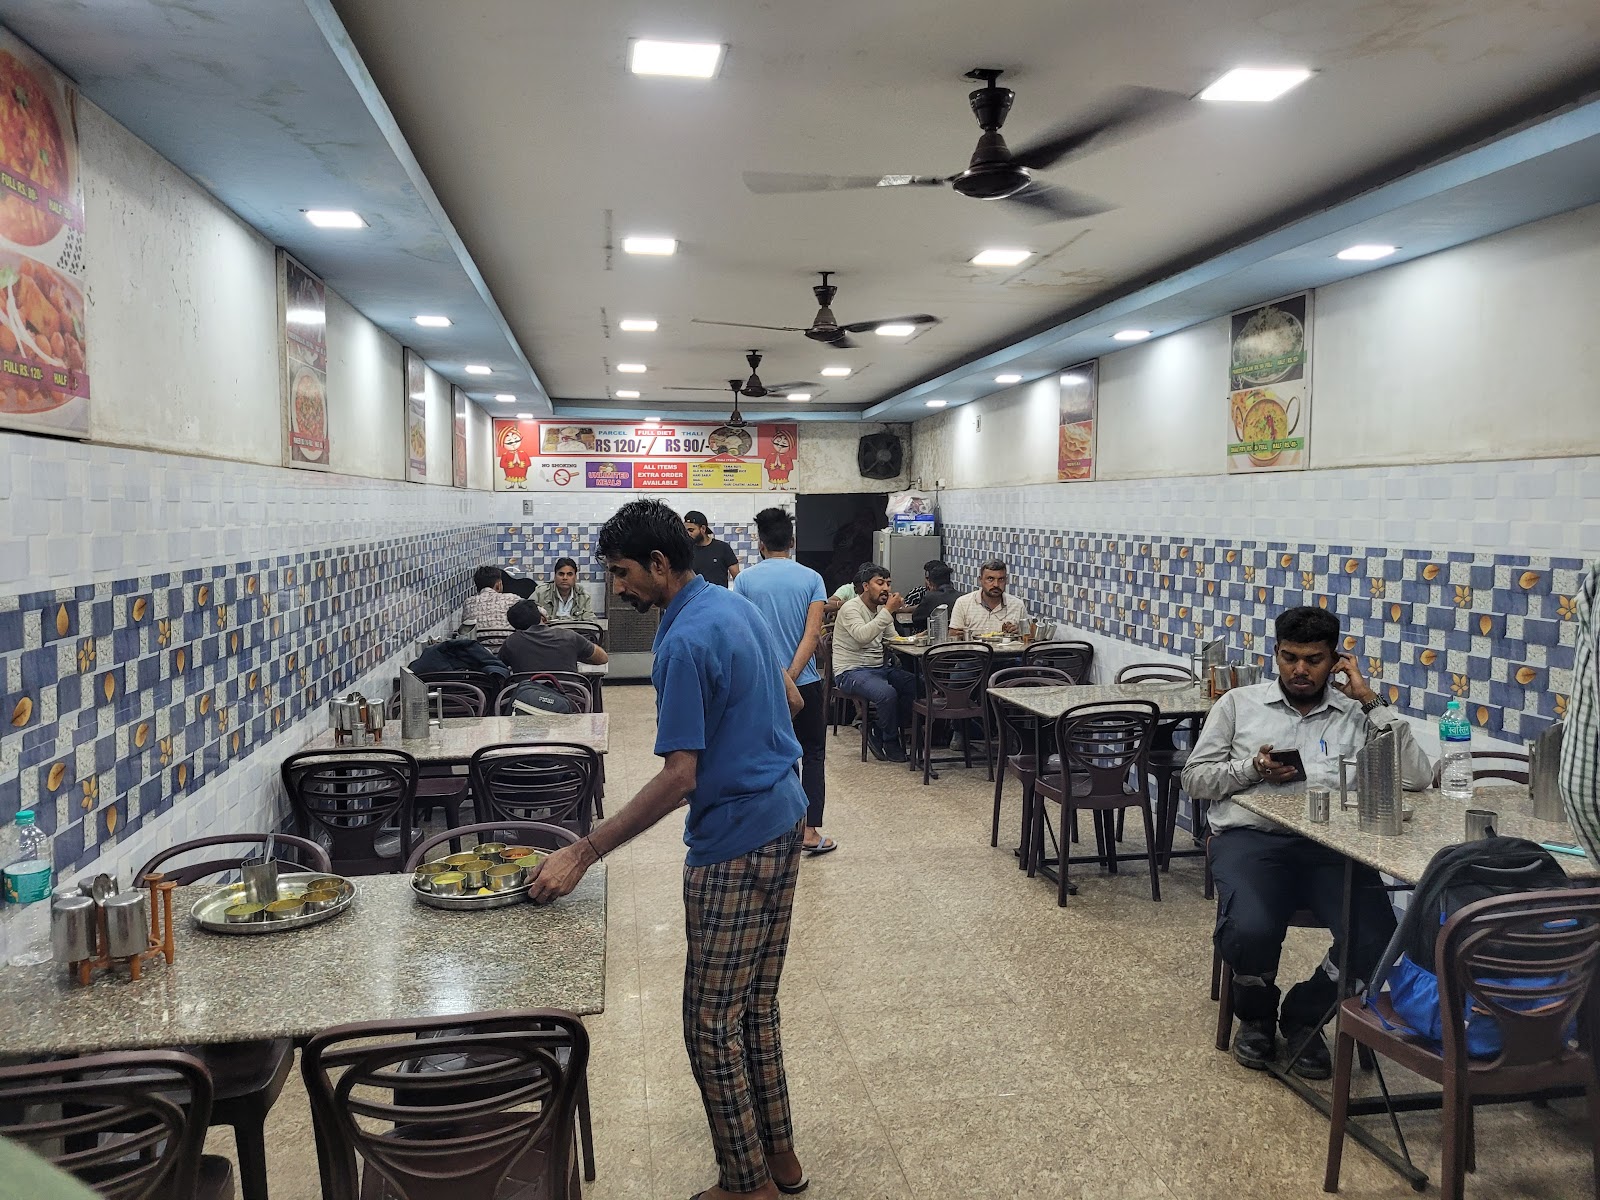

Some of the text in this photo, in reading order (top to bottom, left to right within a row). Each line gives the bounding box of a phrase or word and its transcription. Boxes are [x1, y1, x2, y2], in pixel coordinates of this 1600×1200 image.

[1, 172, 17, 191] FULL
[3, 359, 19, 375] FULL
[53, 372, 68, 386] HALF
[595, 439, 646, 453] RS 120/-
[665, 439, 710, 453] RS 90/-
[588, 471, 630, 479] UNLIMITED
[595, 478, 622, 486] MEALS
